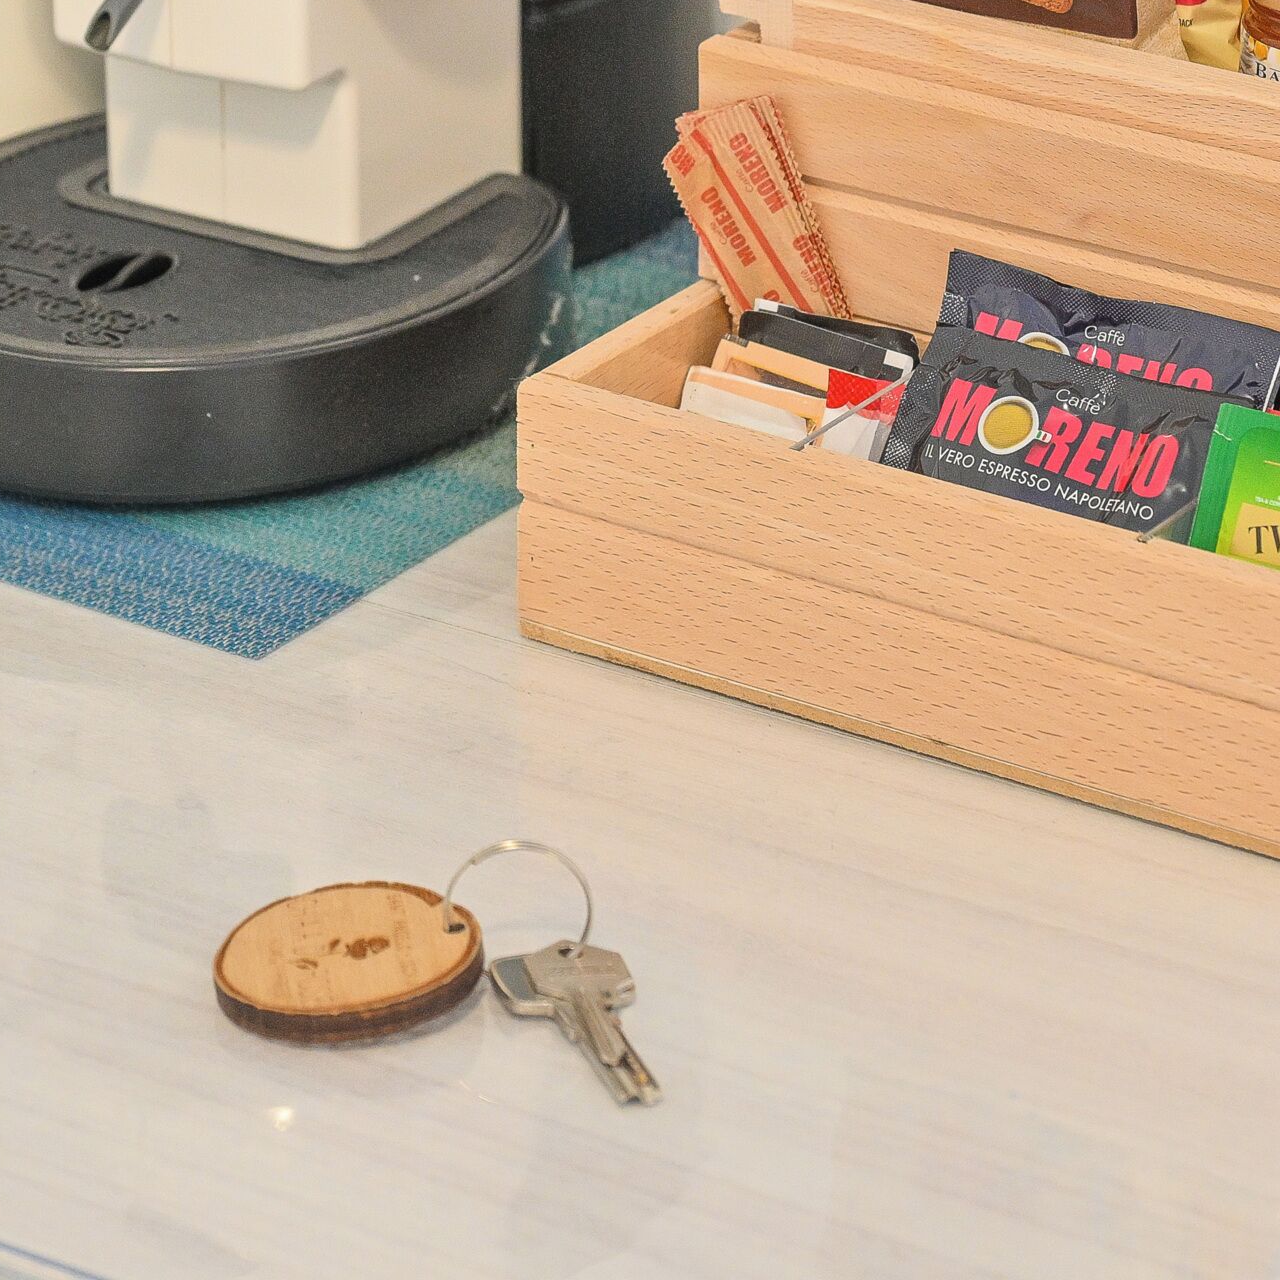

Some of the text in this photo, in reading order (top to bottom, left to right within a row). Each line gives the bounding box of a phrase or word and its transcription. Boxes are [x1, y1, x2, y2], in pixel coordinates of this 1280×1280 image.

[728, 132, 789, 214] MORENO
[700, 186, 758, 268] MORENO
[1084, 324, 1126, 347] Caffè
[1055, 388, 1102, 415] Caffè
[925, 443, 1154, 521] IL VERO ESPRESSO NAPOLETANO
